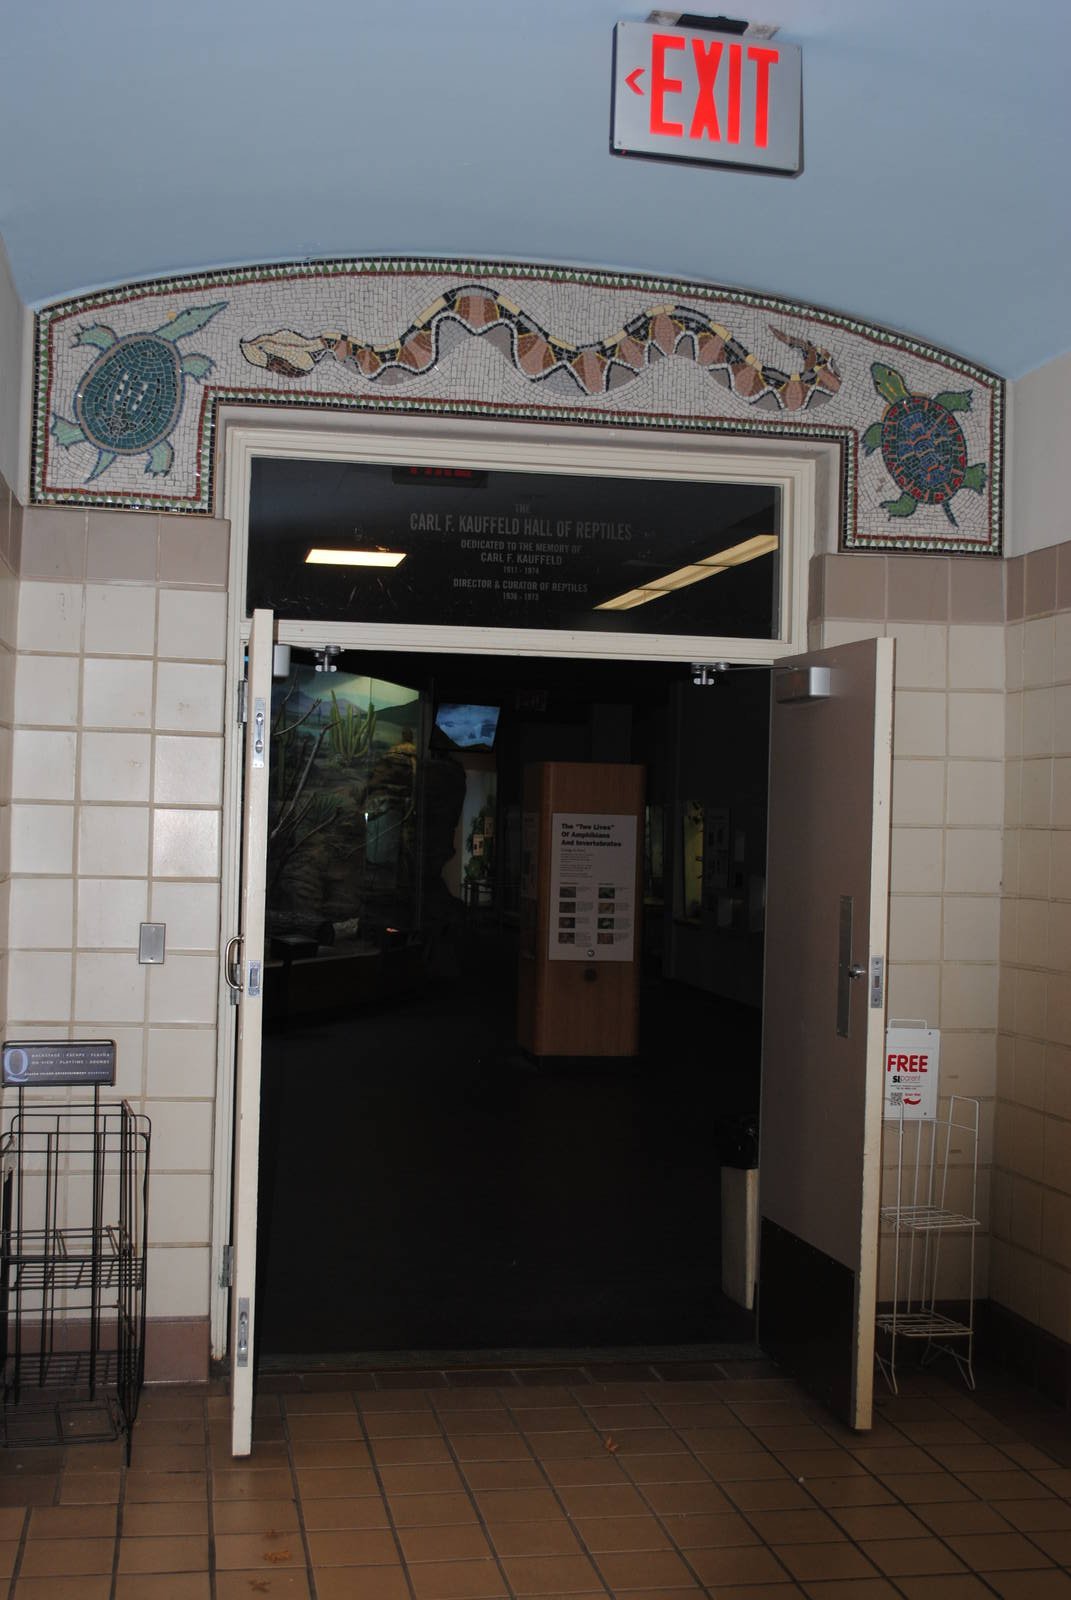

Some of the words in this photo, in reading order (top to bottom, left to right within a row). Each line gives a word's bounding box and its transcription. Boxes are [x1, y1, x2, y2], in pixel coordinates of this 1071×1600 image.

[650, 33, 780, 148] EXIT
[514, 503, 531, 514] THE
[409, 512, 441, 532] CARL
[445, 514, 455, 532] F.
[459, 515, 520, 536] KAUFFELD
[523, 518, 553, 537] HALL
[556, 520, 573, 538] OF
[576, 521, 633, 541] REPTILES
[460, 539, 505, 550] DEDICATED
[507, 541, 517, 551] TO
[519, 542, 533, 552] THE
[535, 543, 570, 553] MEMORY
[480, 551, 504, 563] CARL
[506, 553, 514, 563] F.
[516, 554, 563, 565] KAUFFELD
[453, 578, 492, 589] DIRECTOR
[494, 580, 500, 590] &
[502, 580, 538, 591] CURATOR
[539, 582, 550, 591] OF
[552, 582, 588, 593] REPTILES
[571, 831, 610, 840] Amphibians
[576, 839, 622, 848] Invertebrates
[4, 1048, 29, 1082] Q
[887, 1054, 928, 1073] FREE
